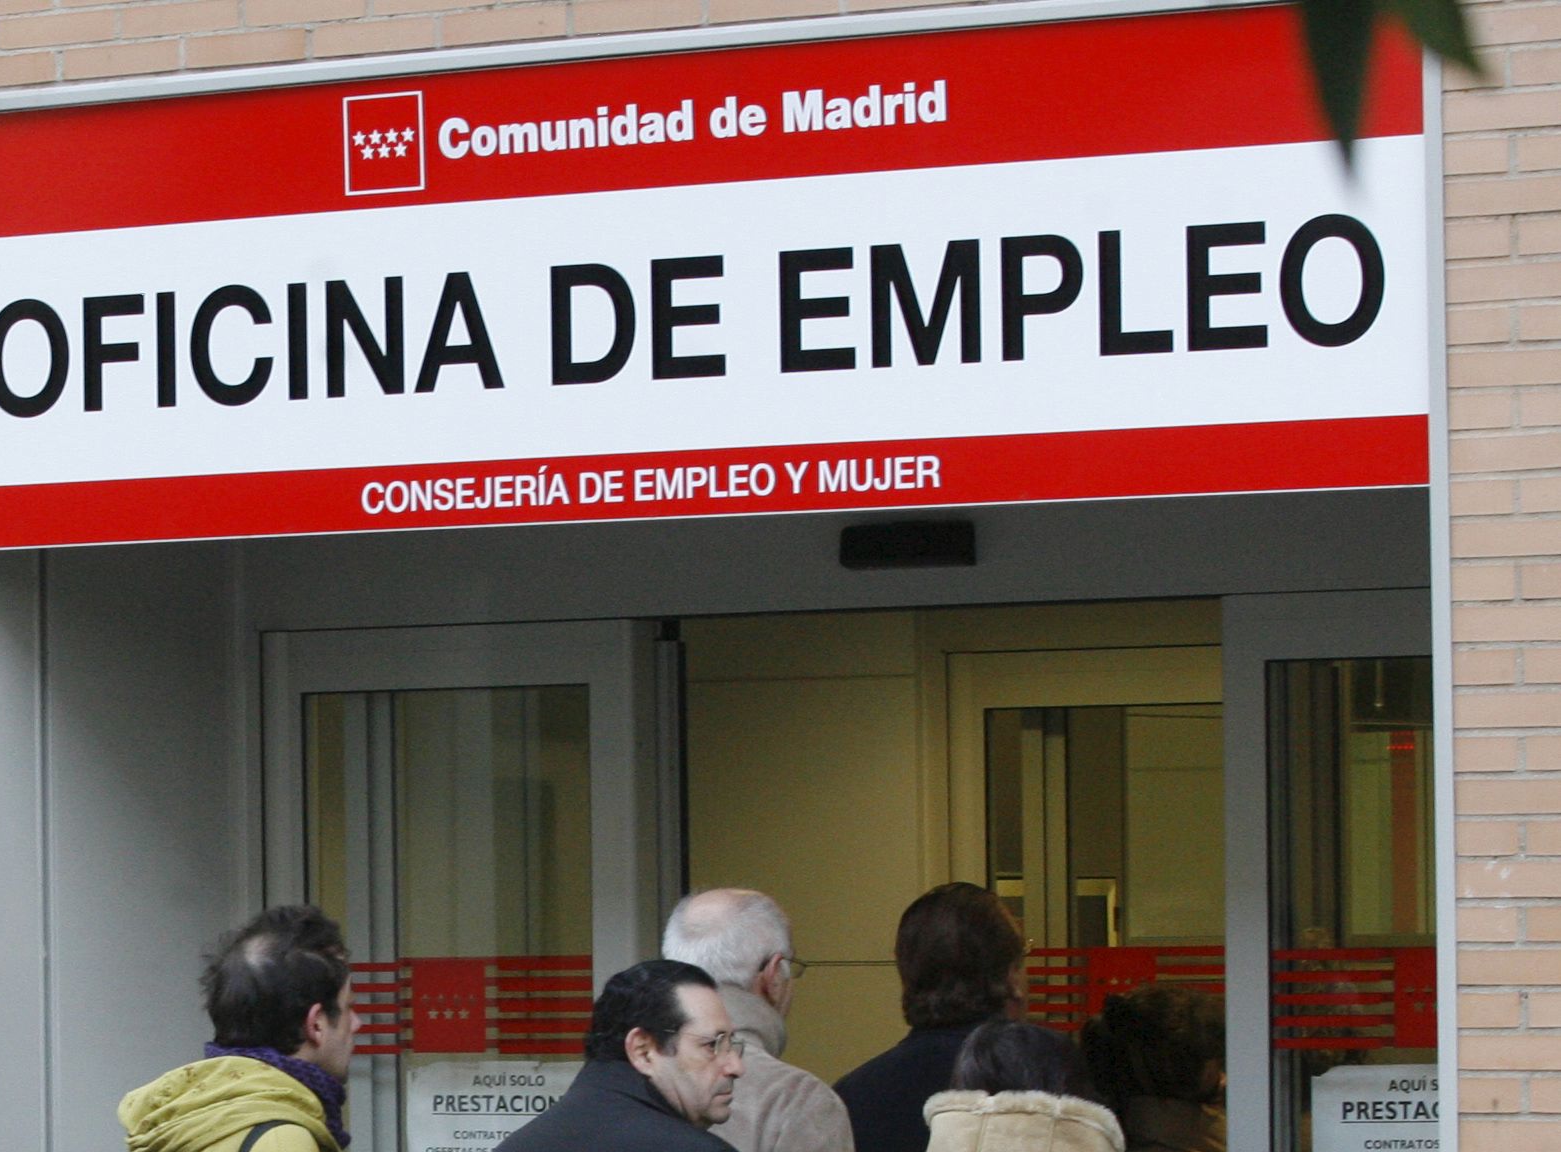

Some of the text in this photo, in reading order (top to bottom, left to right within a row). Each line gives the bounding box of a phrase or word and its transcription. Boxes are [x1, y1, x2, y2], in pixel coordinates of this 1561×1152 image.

[438, 79, 948, 159] Comunidad de Madrid
[550, 254, 726, 386] DE
[778, 213, 1386, 374] EMPLEO
[360, 455, 942, 515] CONSEJERÍA DE EMPLEO Y MUJER
[472, 1072, 546, 1088] AQUÍ SOLO
[1388, 1076, 1426, 1094] AQUÍ
